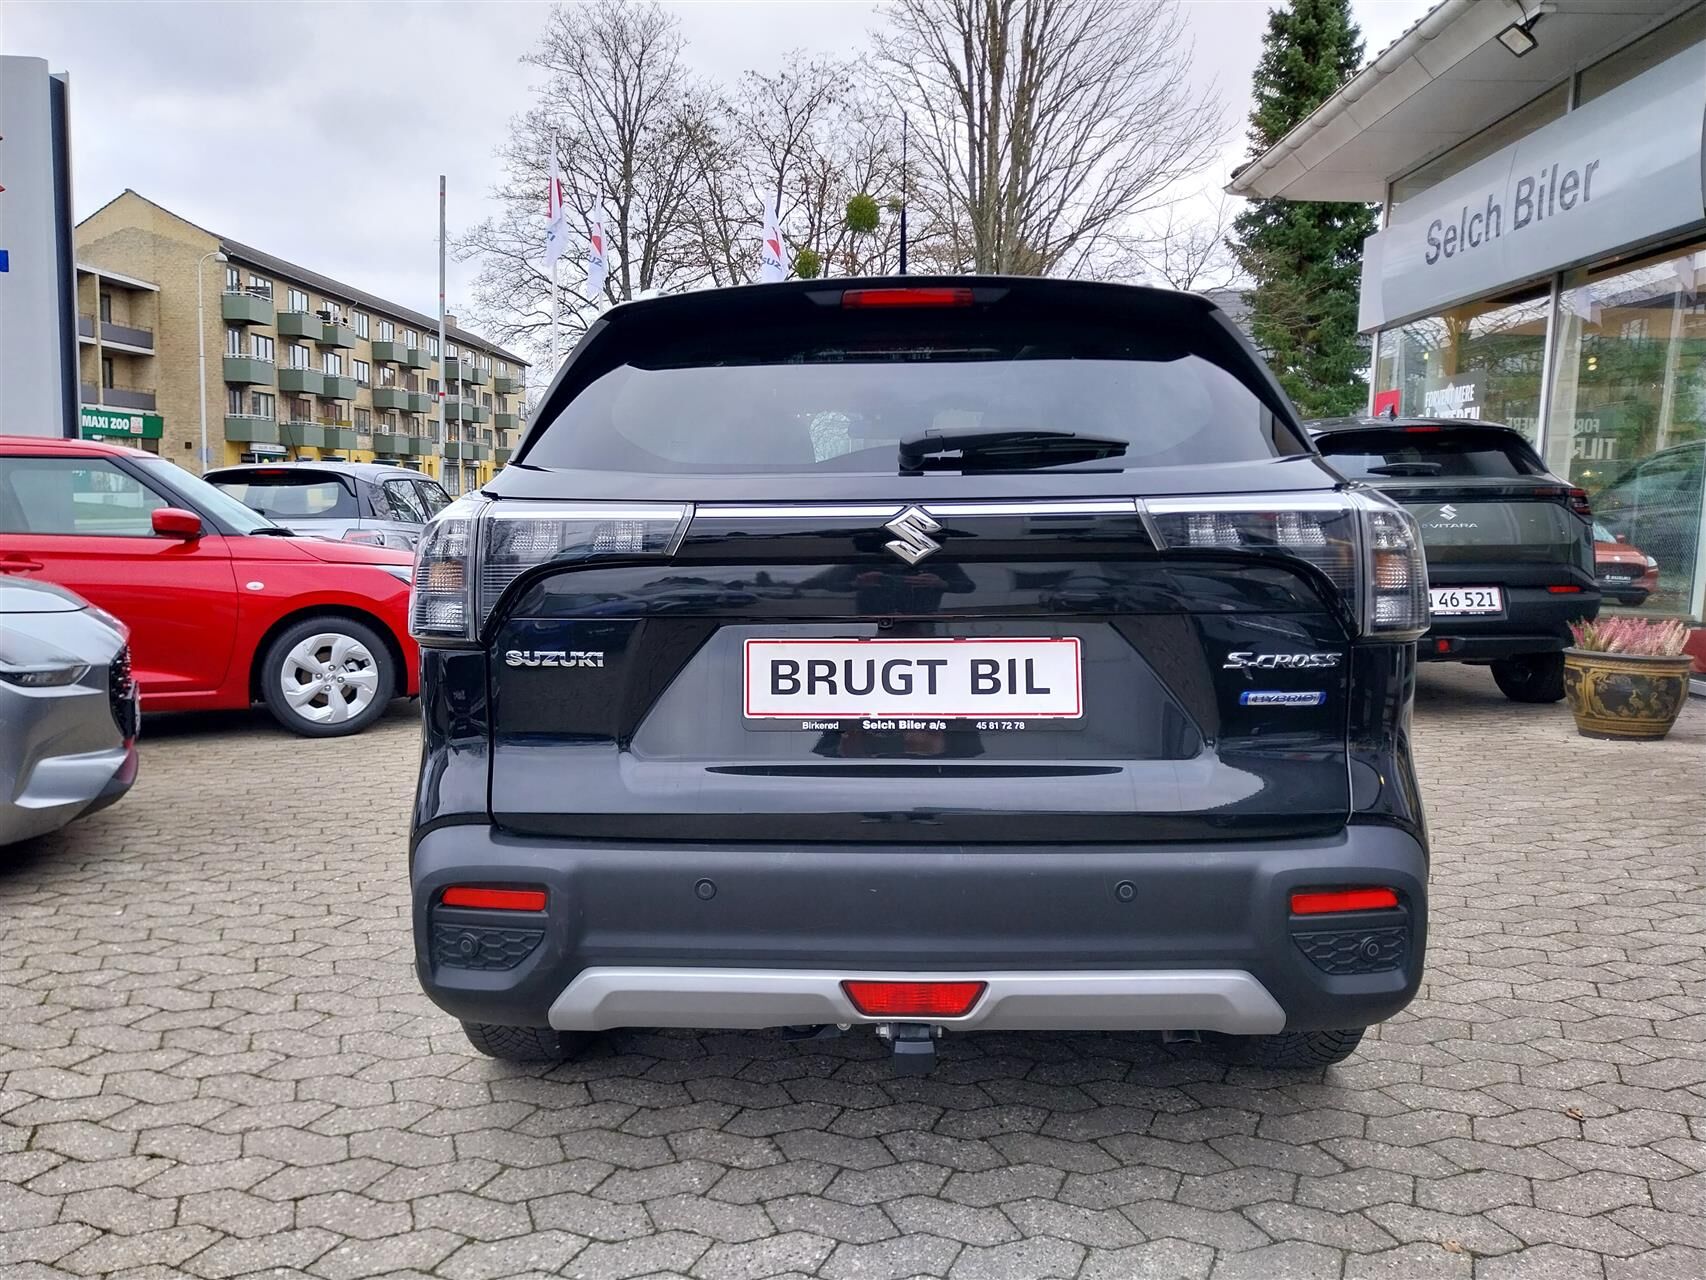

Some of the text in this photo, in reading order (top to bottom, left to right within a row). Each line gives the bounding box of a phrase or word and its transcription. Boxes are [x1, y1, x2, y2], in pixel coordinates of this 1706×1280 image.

[1425, 159, 1600, 265] Selch Biler
[1455, 384, 1475, 402] MERE
[82, 415, 129, 430] MAXI ZOO
[1439, 592, 1460, 607] 46
[1464, 592, 1496, 607] 521
[505, 650, 604, 667] SUZUKI
[770, 658, 1051, 695] BRUGT BIL
[1250, 693, 1316, 703] HYBRID
[802, 721, 839, 730] Birkerød
[862, 720, 947, 730] Selch Biler a/s
[975, 721, 1025, 730] 45 81 72 78
